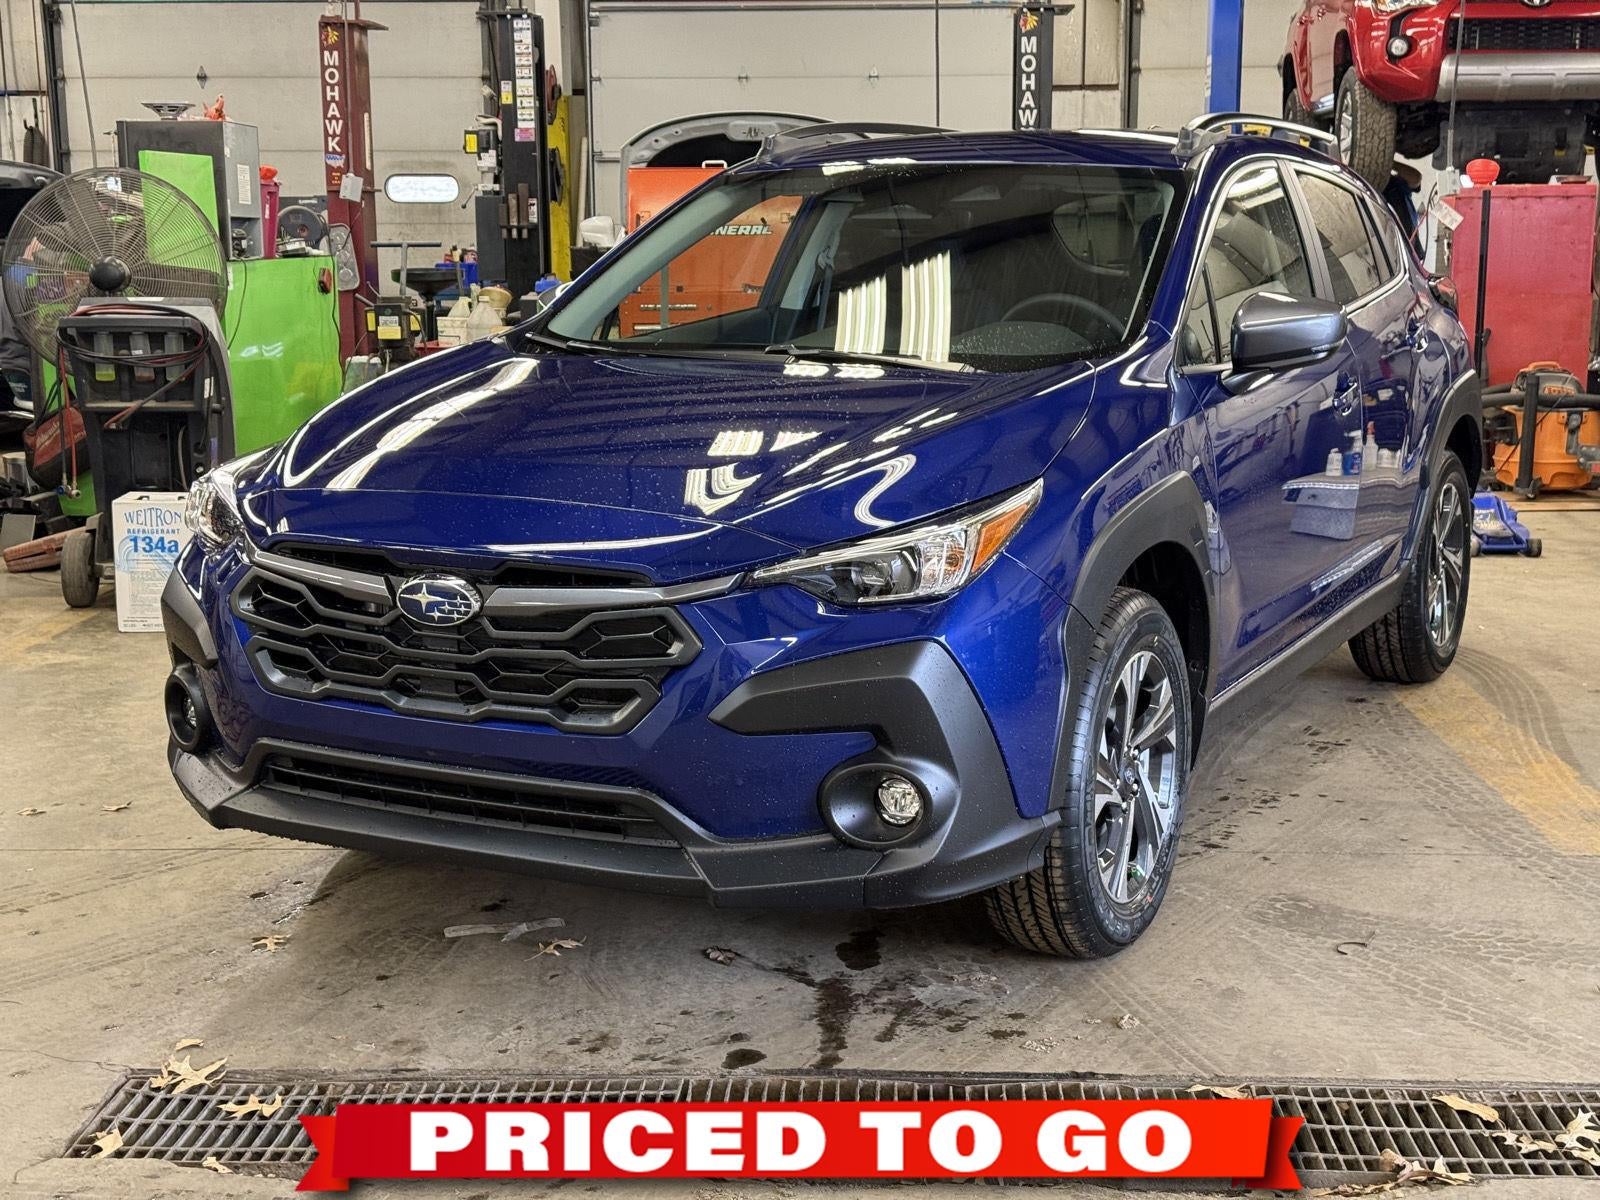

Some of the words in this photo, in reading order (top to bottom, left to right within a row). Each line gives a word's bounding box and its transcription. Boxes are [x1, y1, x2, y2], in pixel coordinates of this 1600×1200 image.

[1018, 36, 1038, 130] MOHAW
[323, 50, 343, 152] MOHAWK
[710, 225, 772, 236] NERAL
[124, 507, 182, 527] WEITRON
[129, 536, 179, 553] 134a
